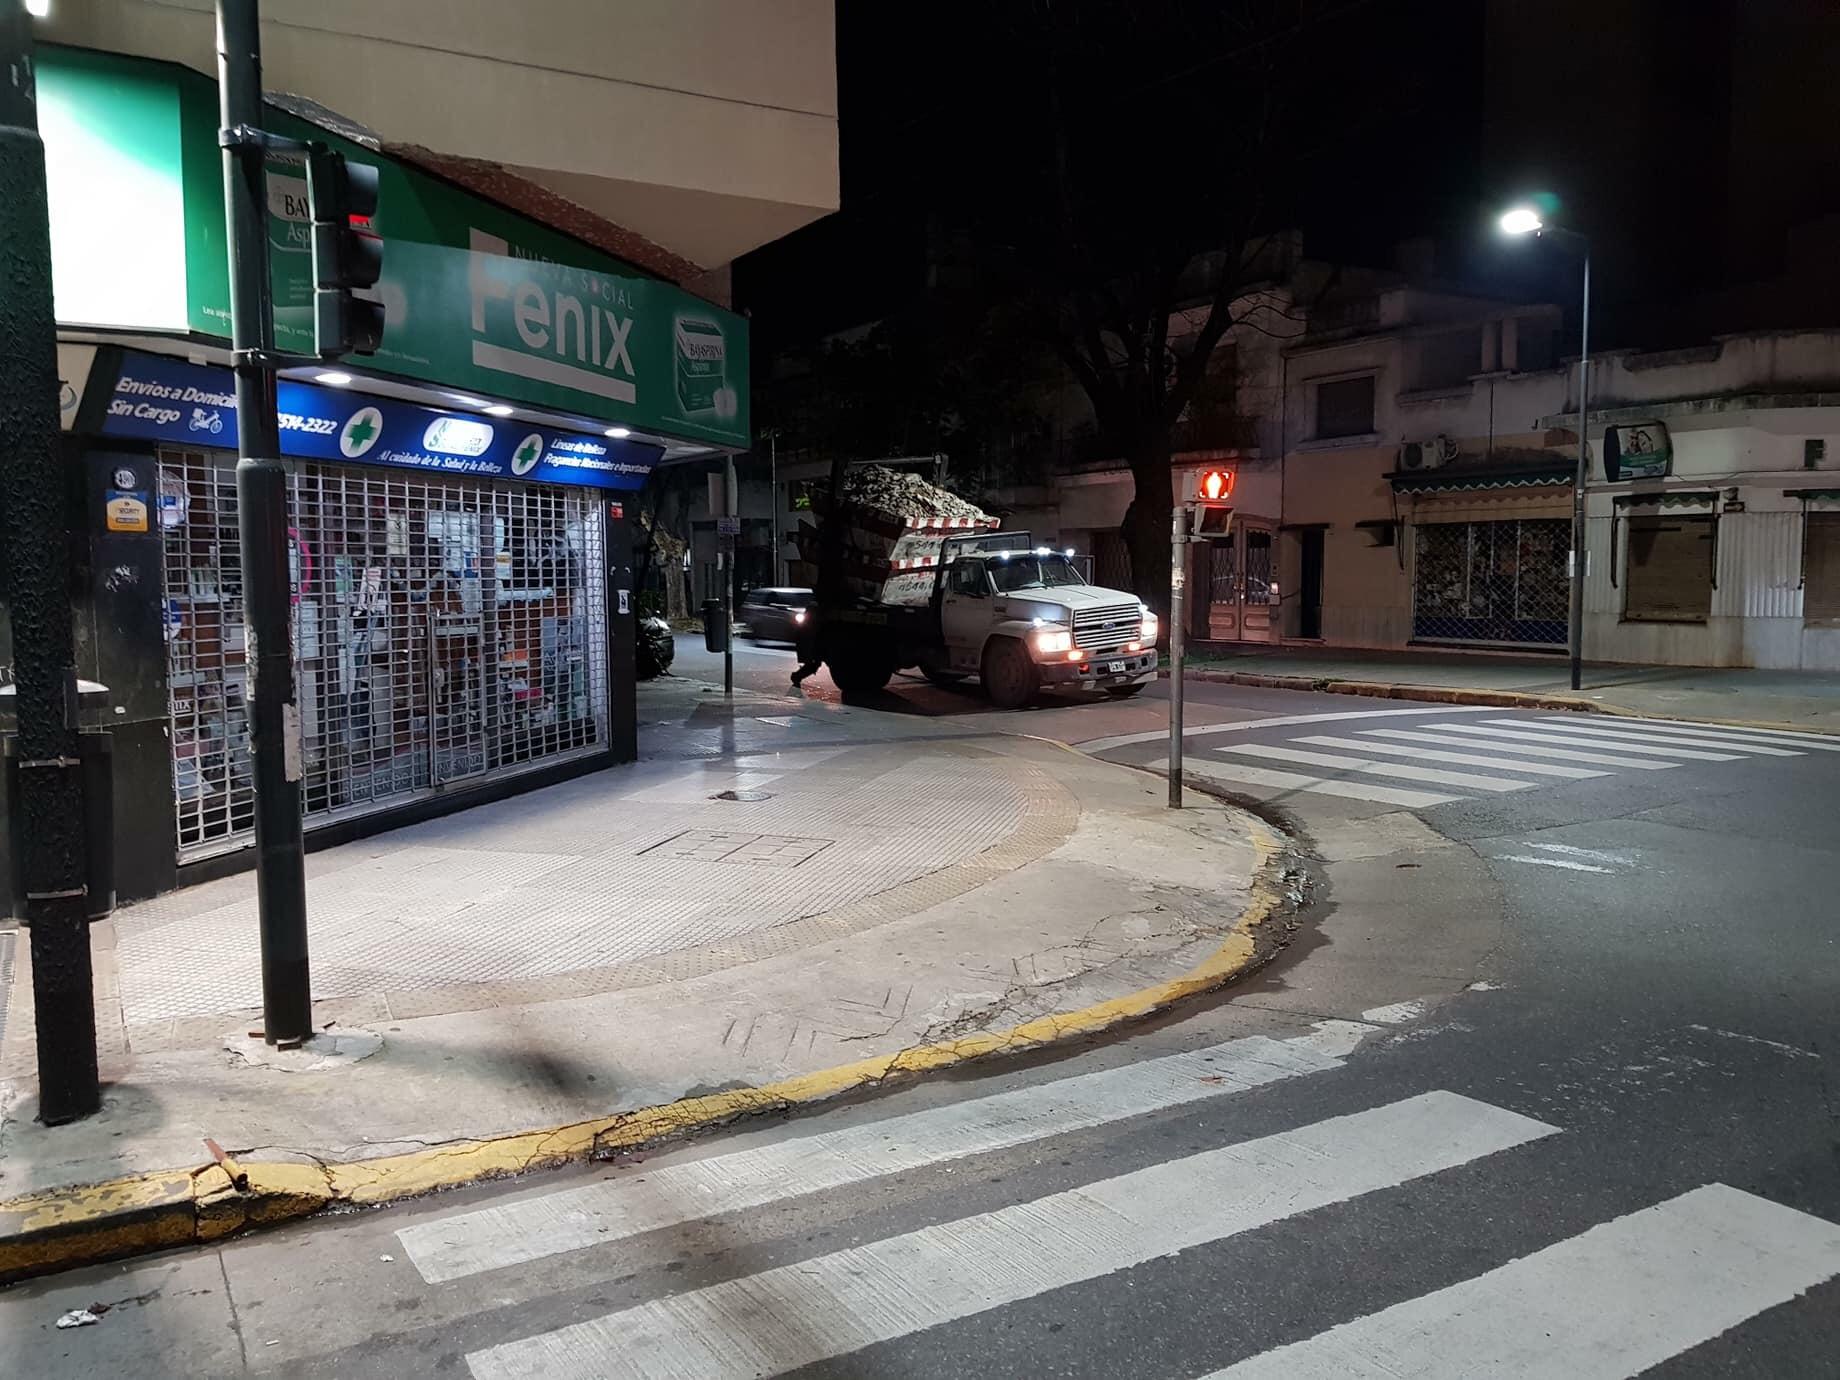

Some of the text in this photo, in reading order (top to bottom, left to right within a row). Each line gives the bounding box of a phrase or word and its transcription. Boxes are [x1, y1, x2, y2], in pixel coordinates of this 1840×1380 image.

[469, 226, 636, 377] Fenix
[169, 388, 182, 401] a
[107, 399, 181, 425] Sin Cargo
[389, 451, 421, 465] cuidado
[421, 455, 432, 466] de
[431, 455, 441, 467] la
[441, 457, 465, 470] Salud
[469, 460, 478, 472] la
[477, 461, 503, 474] Belleza
